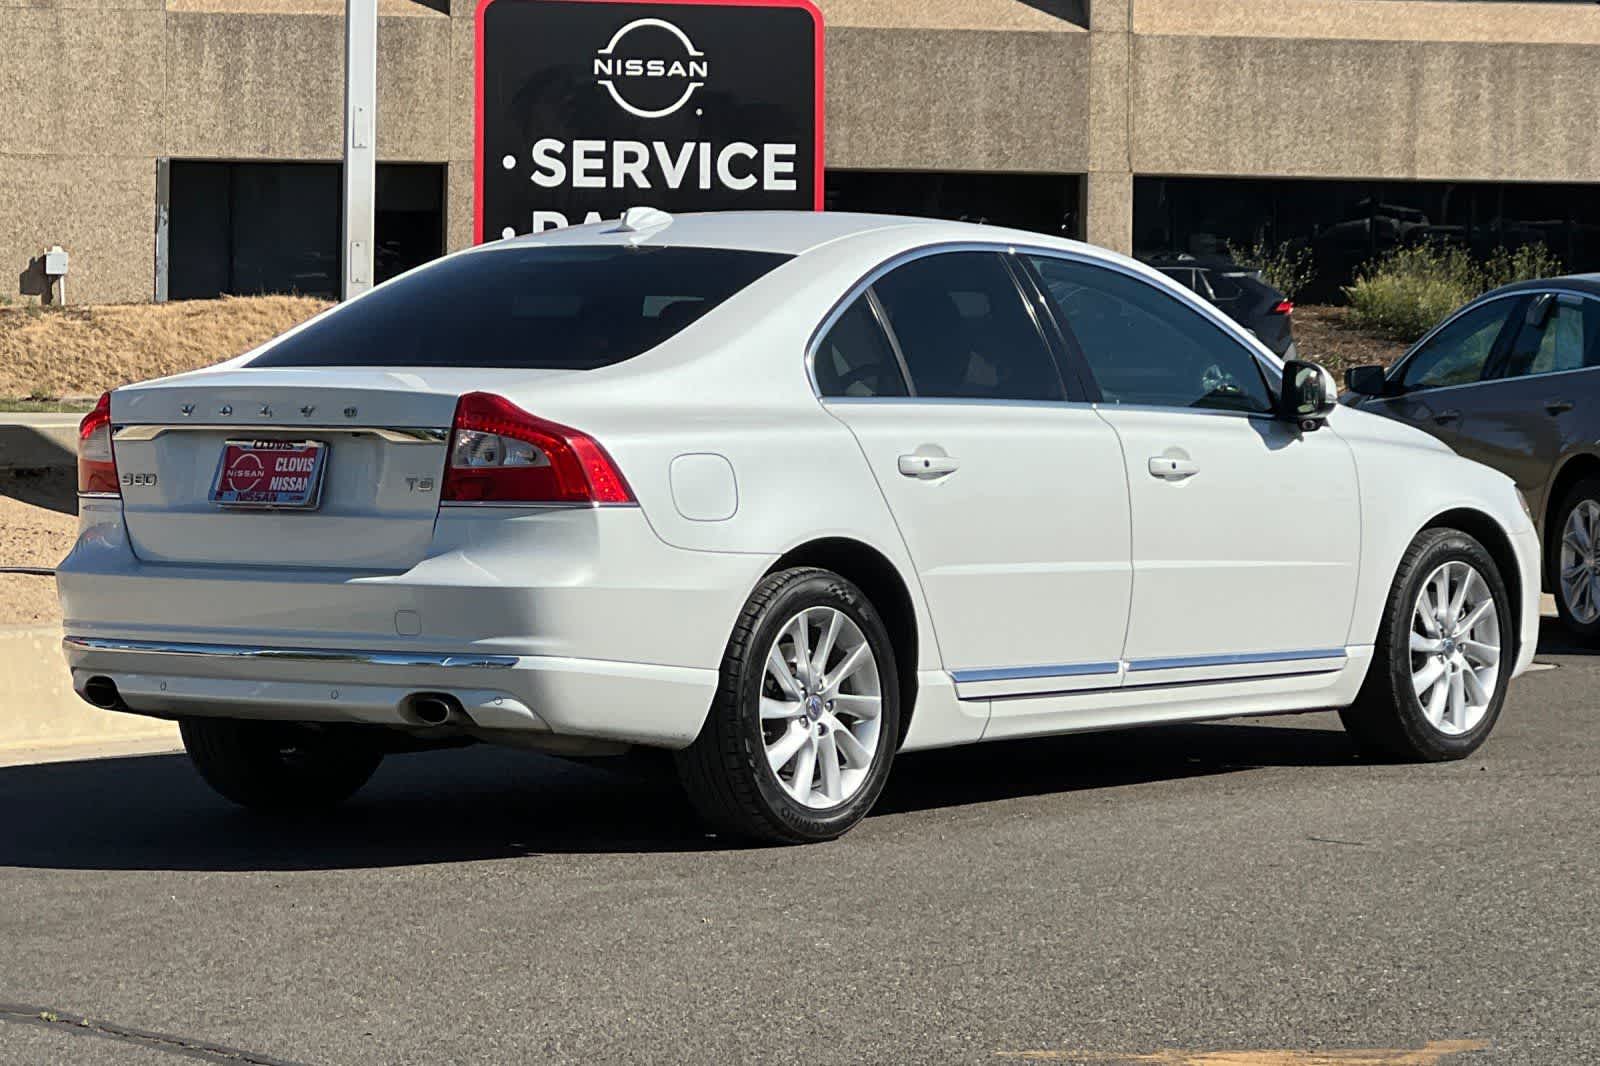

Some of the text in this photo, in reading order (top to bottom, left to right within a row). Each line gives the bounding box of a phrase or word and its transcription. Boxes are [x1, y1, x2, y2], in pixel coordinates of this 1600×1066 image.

[593, 58, 708, 77] NISSAN
[530, 138, 797, 191] SERVICE
[275, 457, 315, 472] CLOVIS
